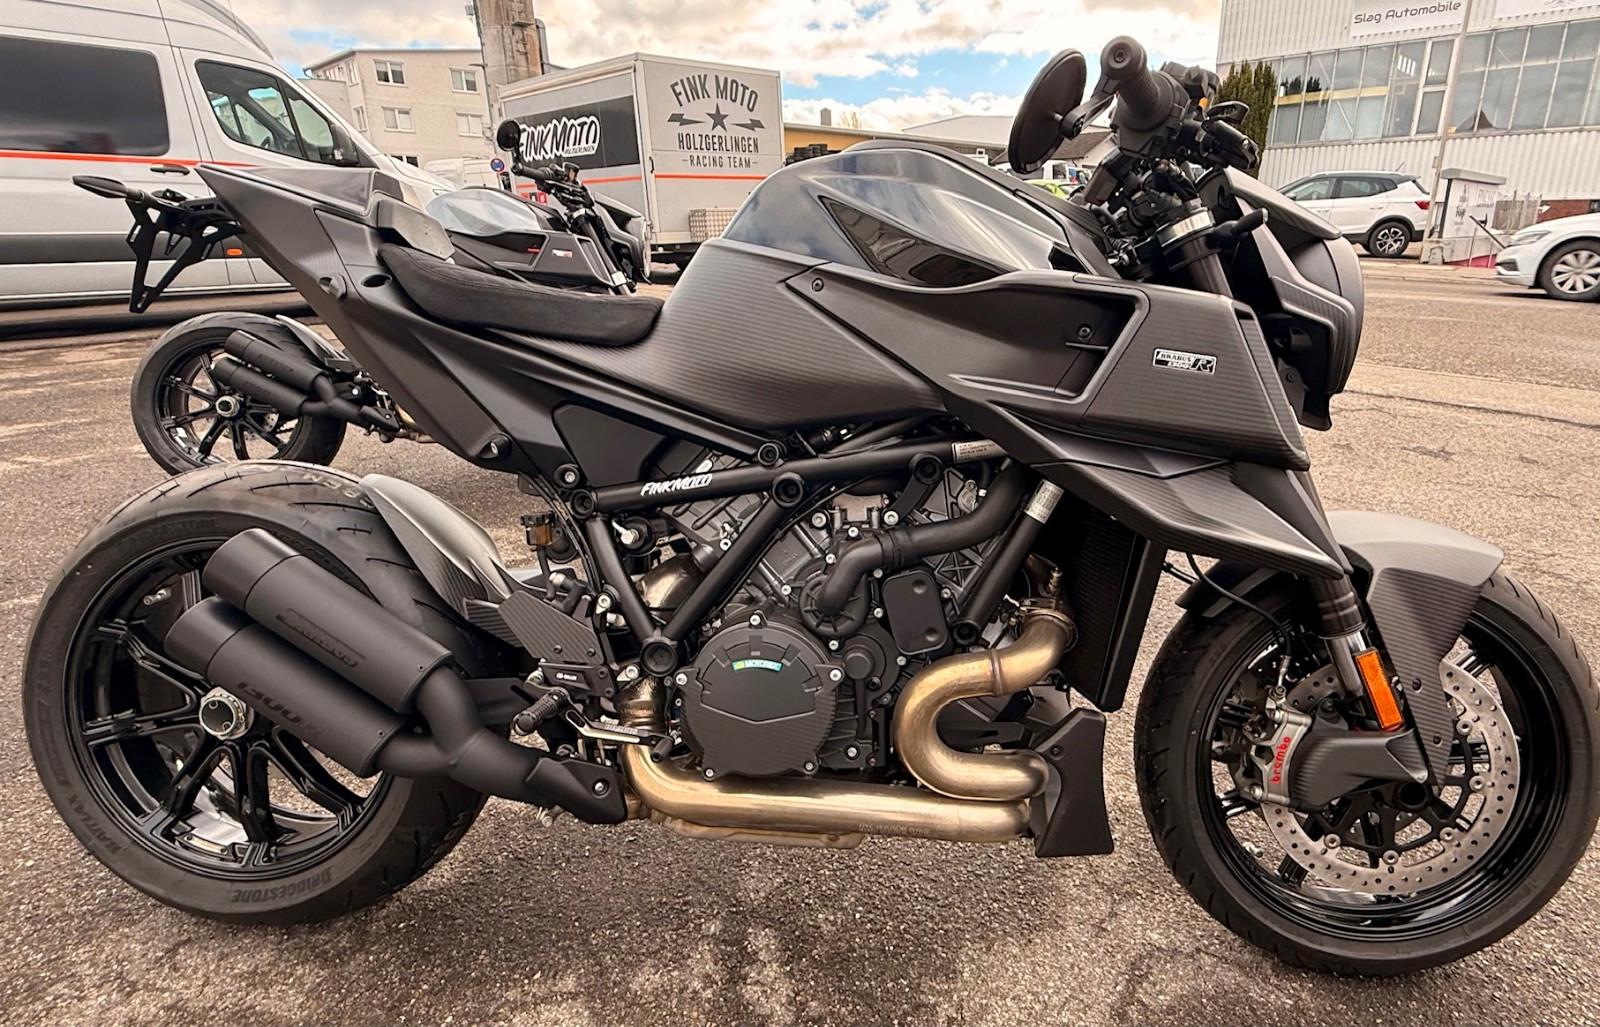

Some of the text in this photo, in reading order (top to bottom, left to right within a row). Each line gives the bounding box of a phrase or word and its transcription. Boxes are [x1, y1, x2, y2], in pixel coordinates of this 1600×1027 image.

[1353, 0, 1462, 25] Slag Automobile
[669, 73, 759, 113] FINK MOTO
[677, 132, 759, 154] HOLZGERLINGEN
[689, 155, 752, 169] RACING TEAM
[1270, 736, 1292, 785] brembo
[231, 865, 336, 904] BRIDGESTONE
